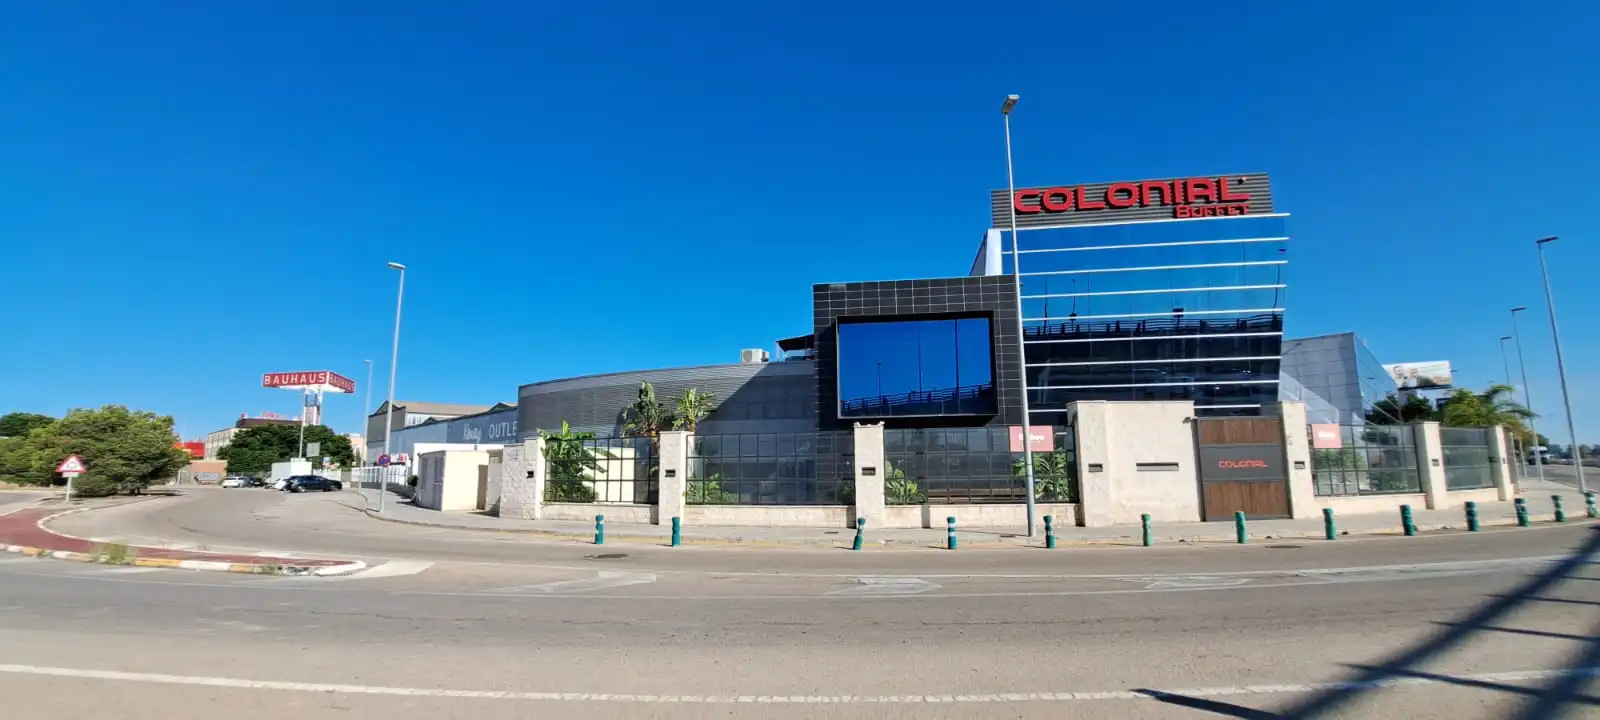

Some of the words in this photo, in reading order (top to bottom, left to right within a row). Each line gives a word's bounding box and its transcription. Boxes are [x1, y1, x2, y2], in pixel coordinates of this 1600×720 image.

[1014, 176, 1250, 213] COLONIAL
[1175, 204, 1250, 218] BUFFET
[263, 373, 326, 386] BAUHAUS
[1218, 459, 1270, 469] COLONIAL
